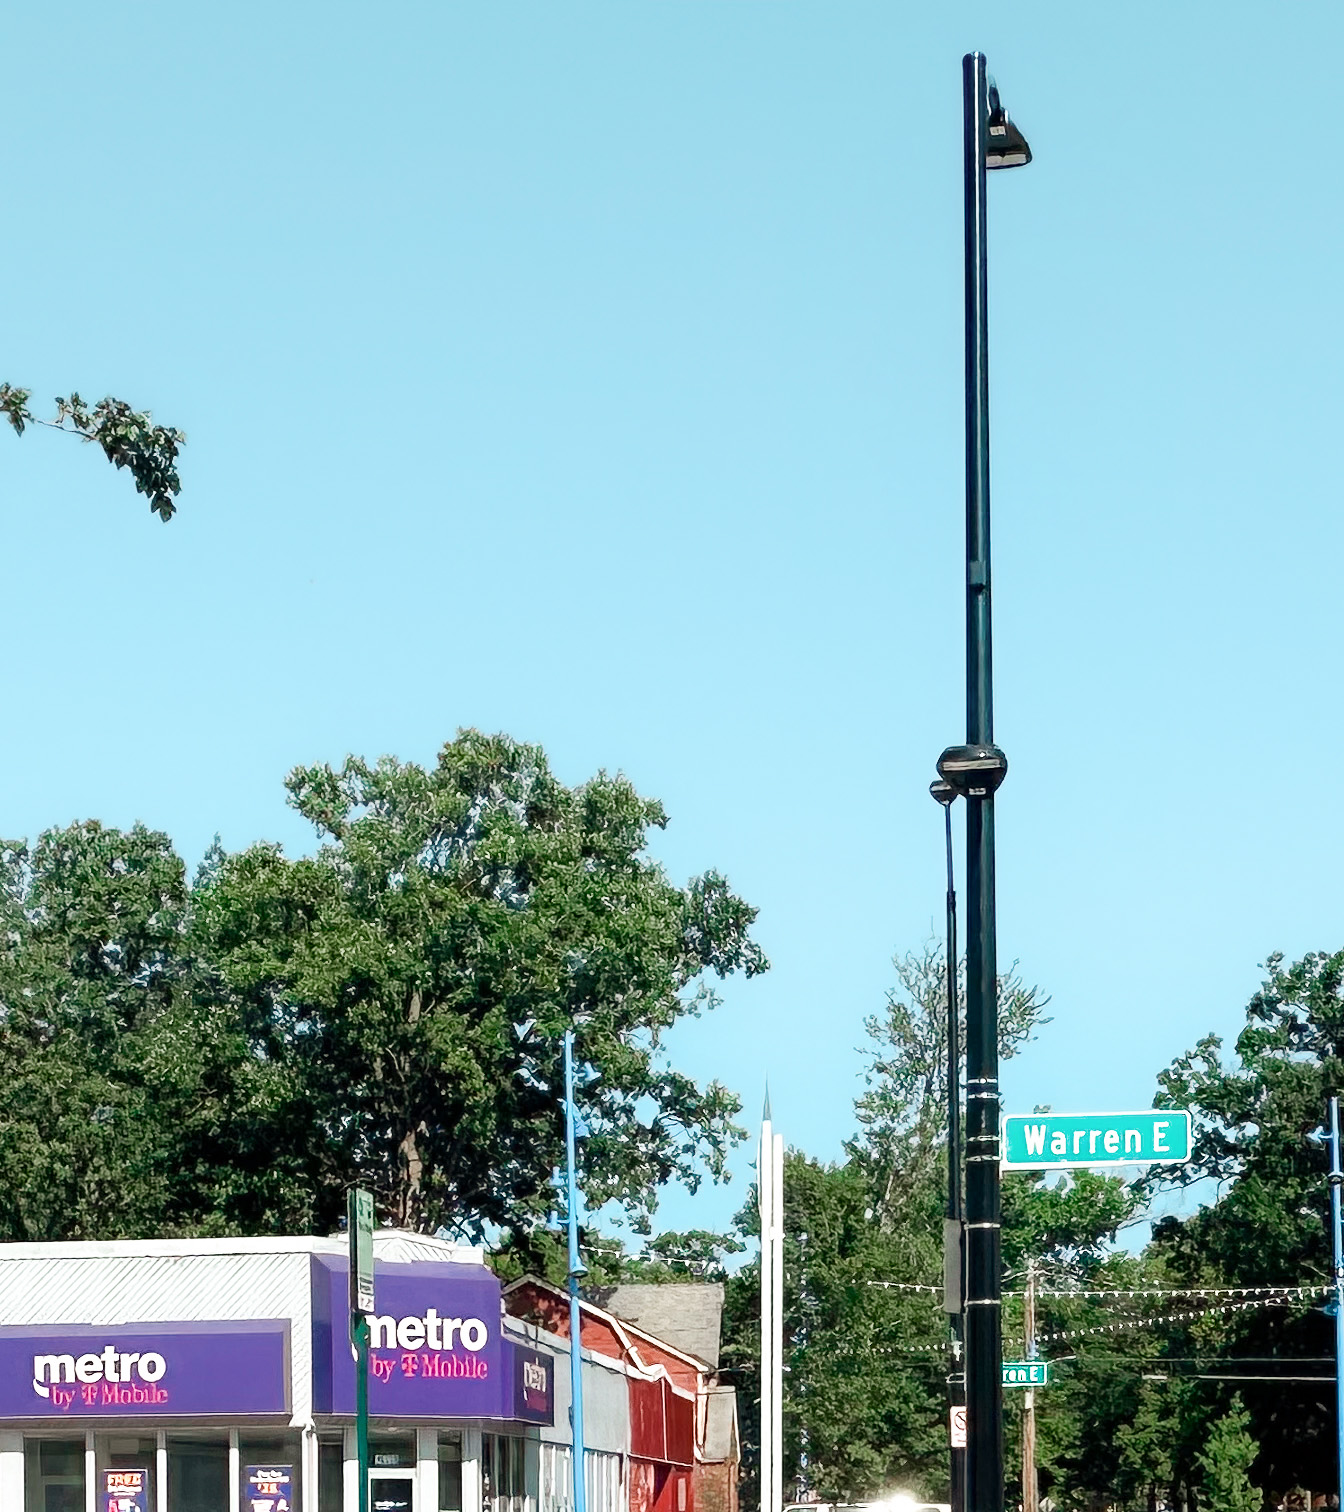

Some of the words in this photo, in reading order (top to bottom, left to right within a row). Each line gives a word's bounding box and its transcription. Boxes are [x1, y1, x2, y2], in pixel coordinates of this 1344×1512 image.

[1024, 1123, 1142, 1156] Warren
[1153, 1121, 1170, 1152] E
[32, 1345, 167, 1398] metro
[370, 1353, 396, 1384] by
[1029, 1366, 1039, 1382] E
[52, 1385, 76, 1411] by
